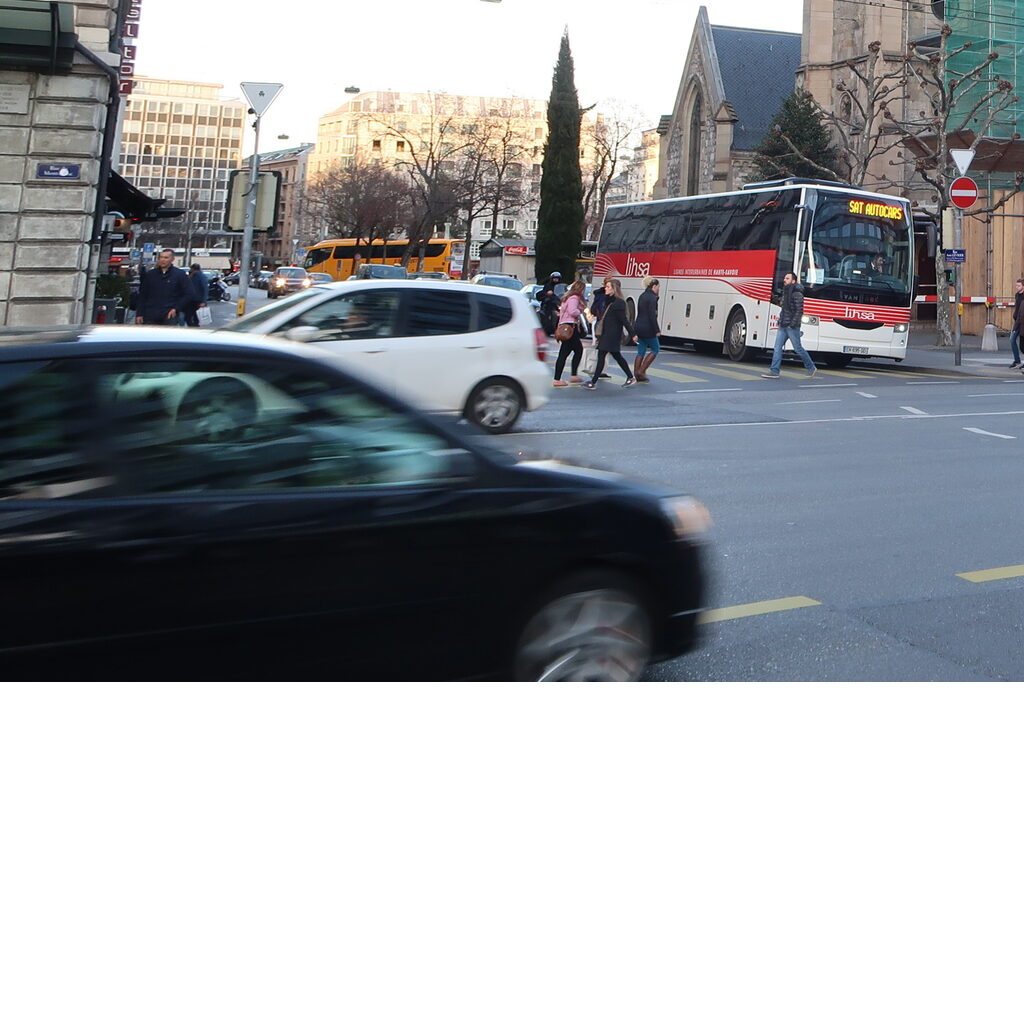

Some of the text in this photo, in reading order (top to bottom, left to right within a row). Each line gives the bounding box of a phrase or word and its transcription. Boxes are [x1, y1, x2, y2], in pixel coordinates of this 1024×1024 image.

[849, 200, 902, 220] SAT AUTOCARS
[625, 253, 650, 276] lihsa
[845, 307, 875, 320] lihsa
